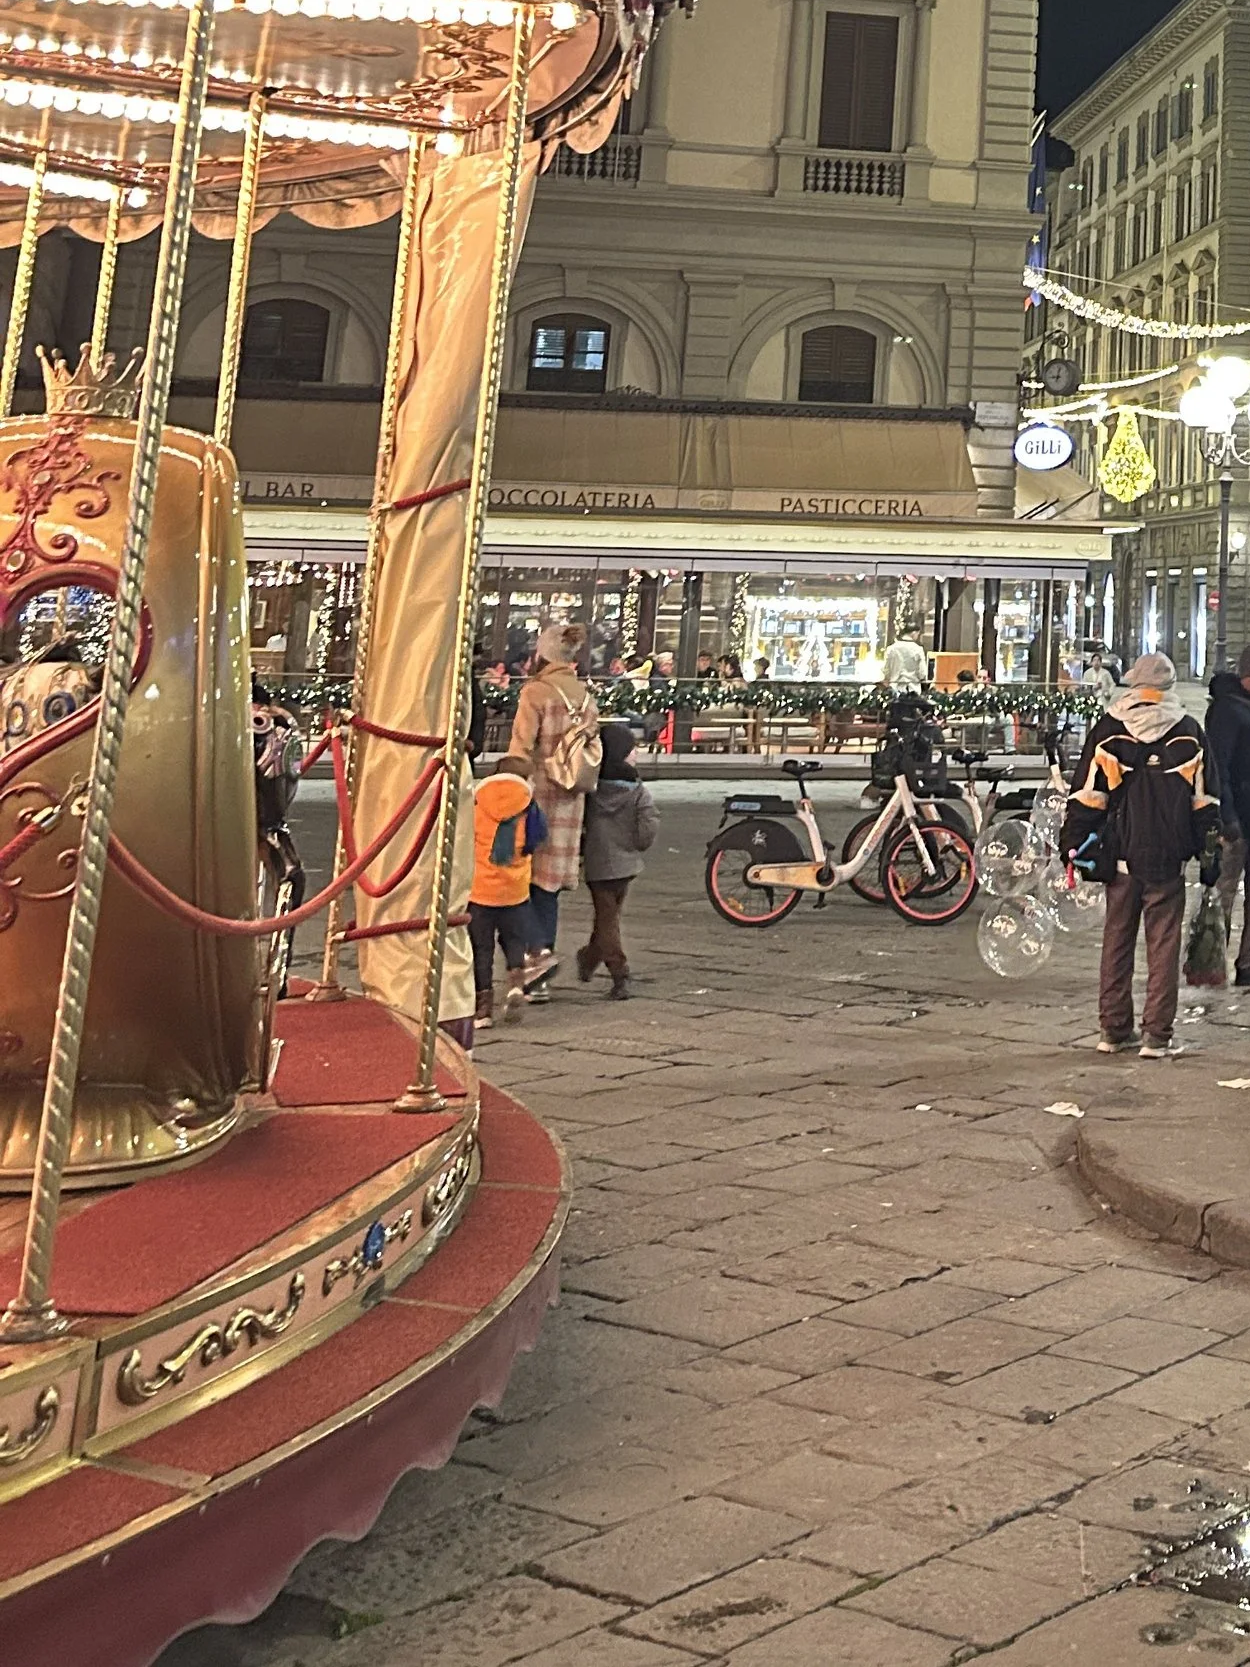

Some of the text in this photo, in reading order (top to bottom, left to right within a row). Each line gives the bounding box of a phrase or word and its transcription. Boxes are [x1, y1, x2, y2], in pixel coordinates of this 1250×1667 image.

[265, 482, 315, 498] BAR
[487, 487, 657, 510] OCCOLATERIA
[780, 496, 924, 517] PASTICCERIA
